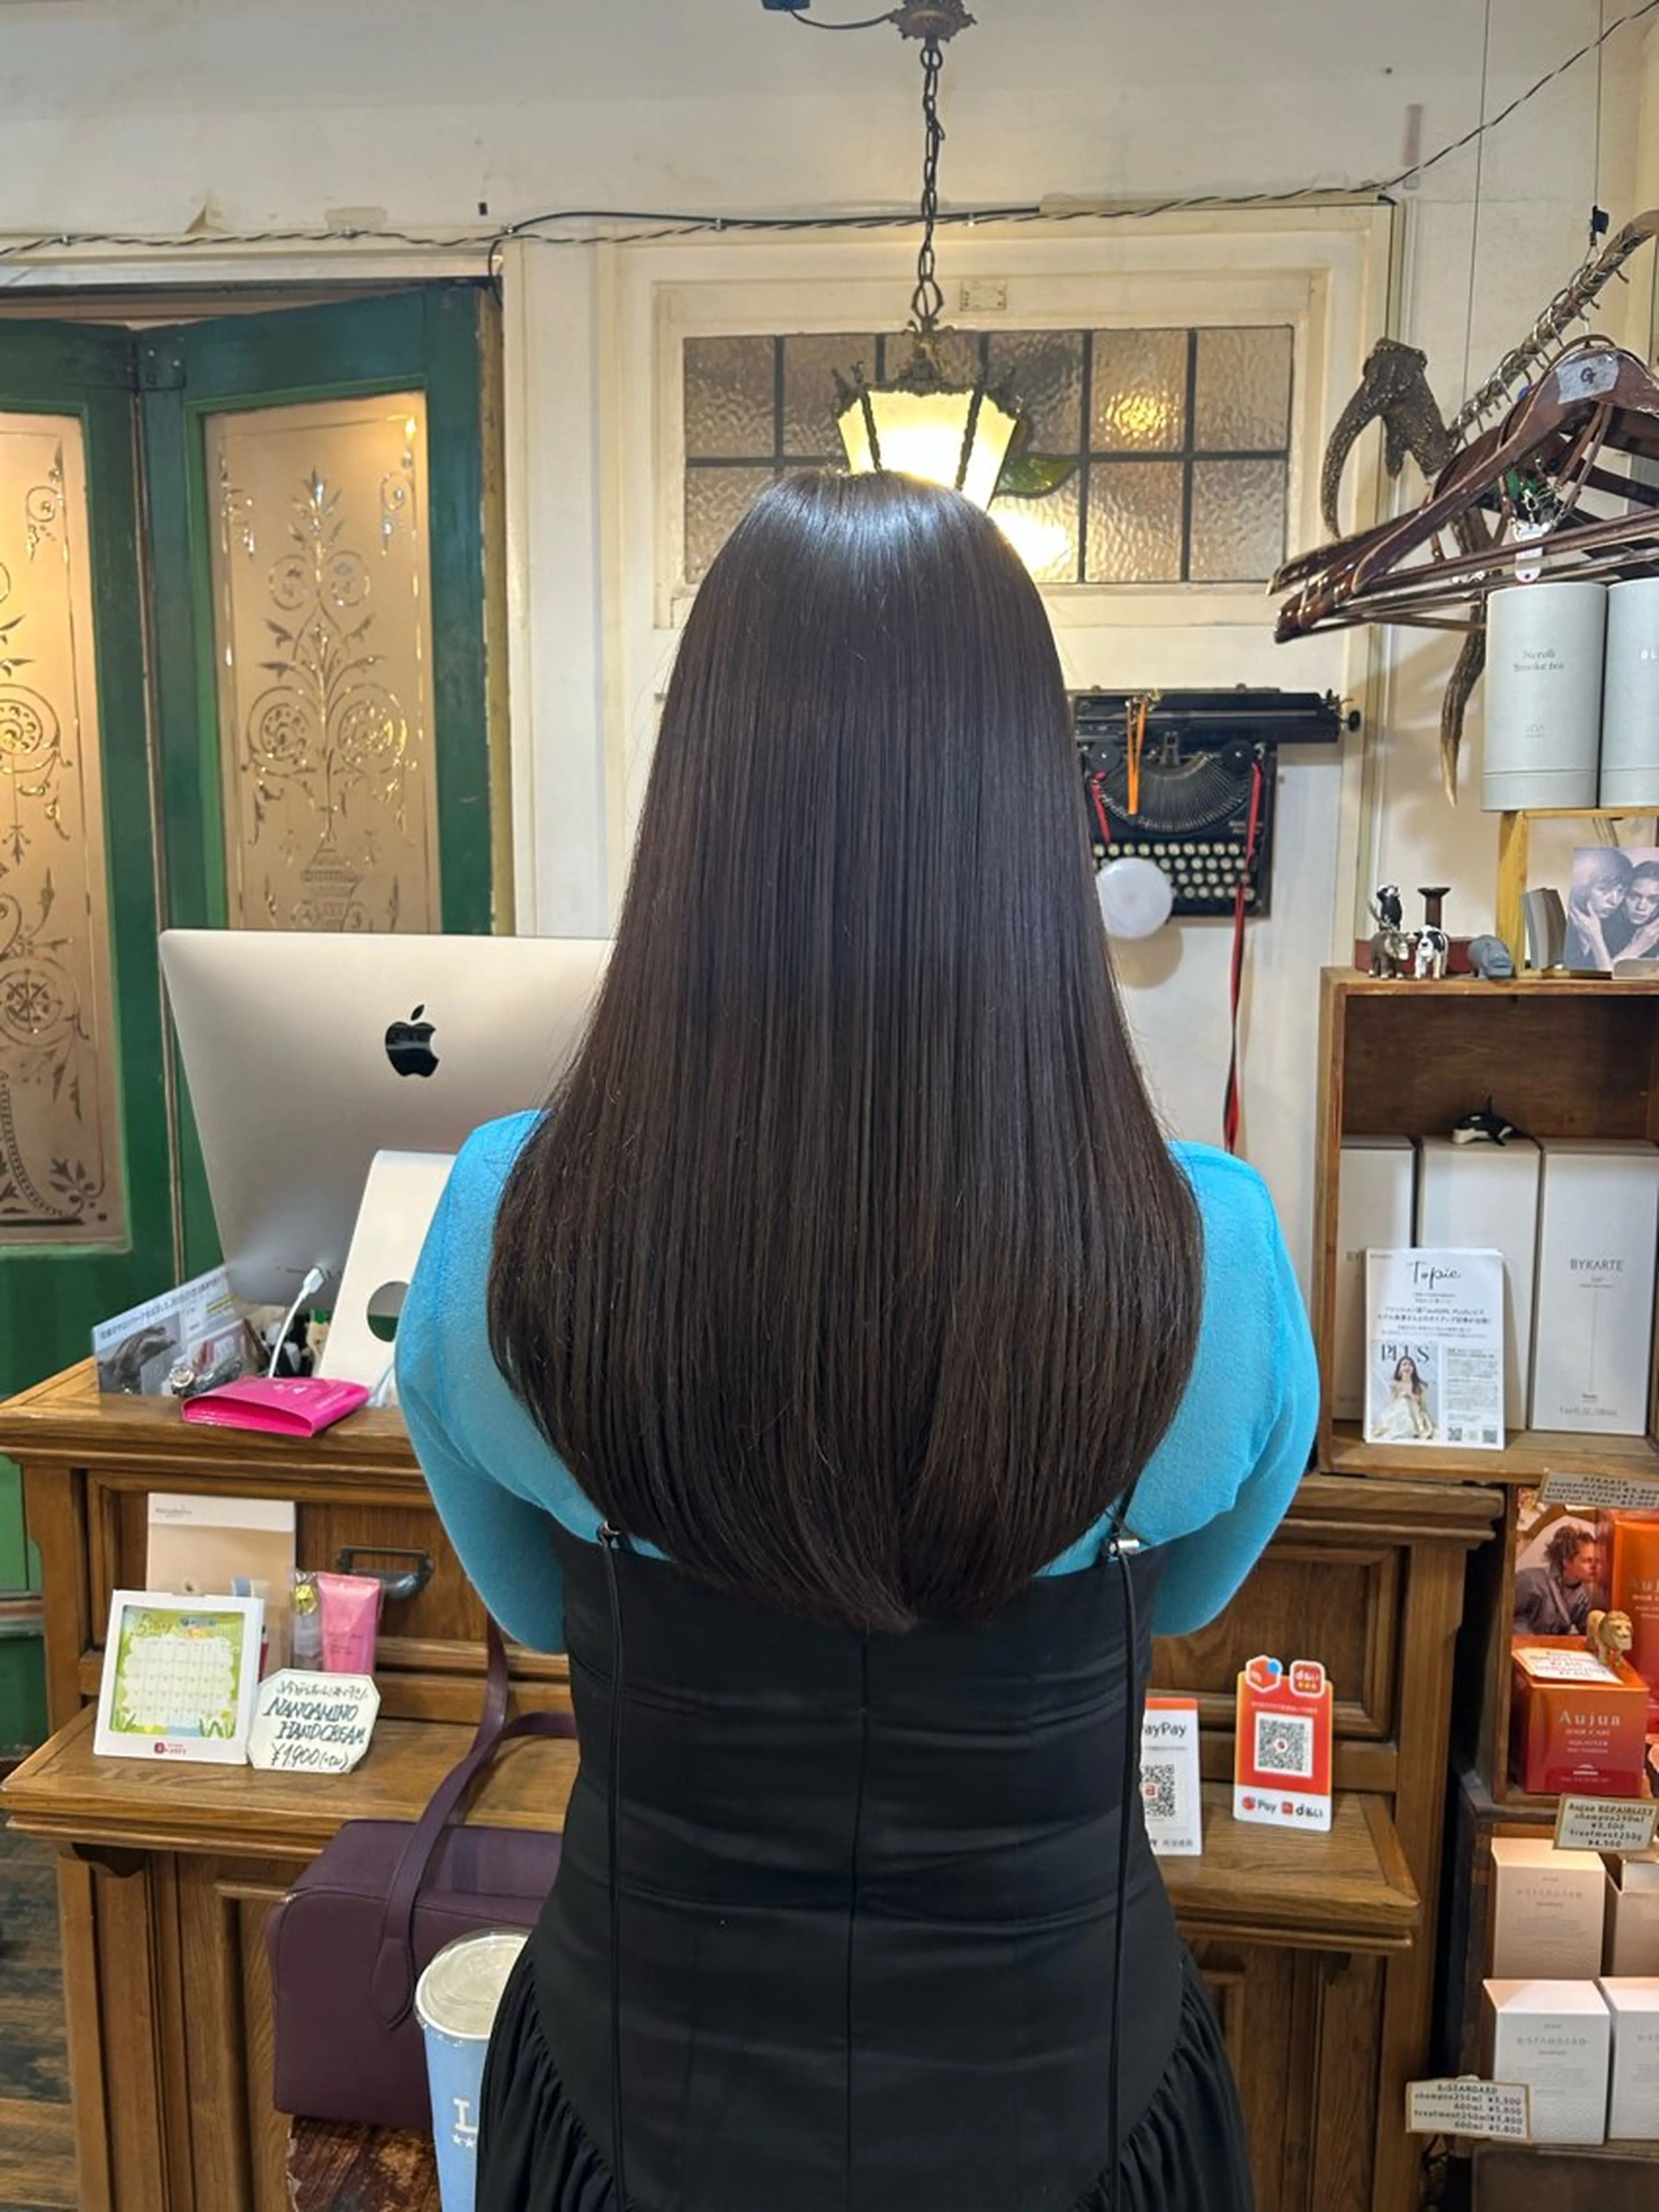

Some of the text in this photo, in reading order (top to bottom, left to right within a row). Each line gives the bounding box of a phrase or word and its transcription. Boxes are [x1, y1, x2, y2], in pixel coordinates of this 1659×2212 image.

[1570, 1259, 1624, 1271] BYKARTE
[1406, 1260, 1461, 1290] Topic
[1144, 1721, 1187, 1738] ayPay
